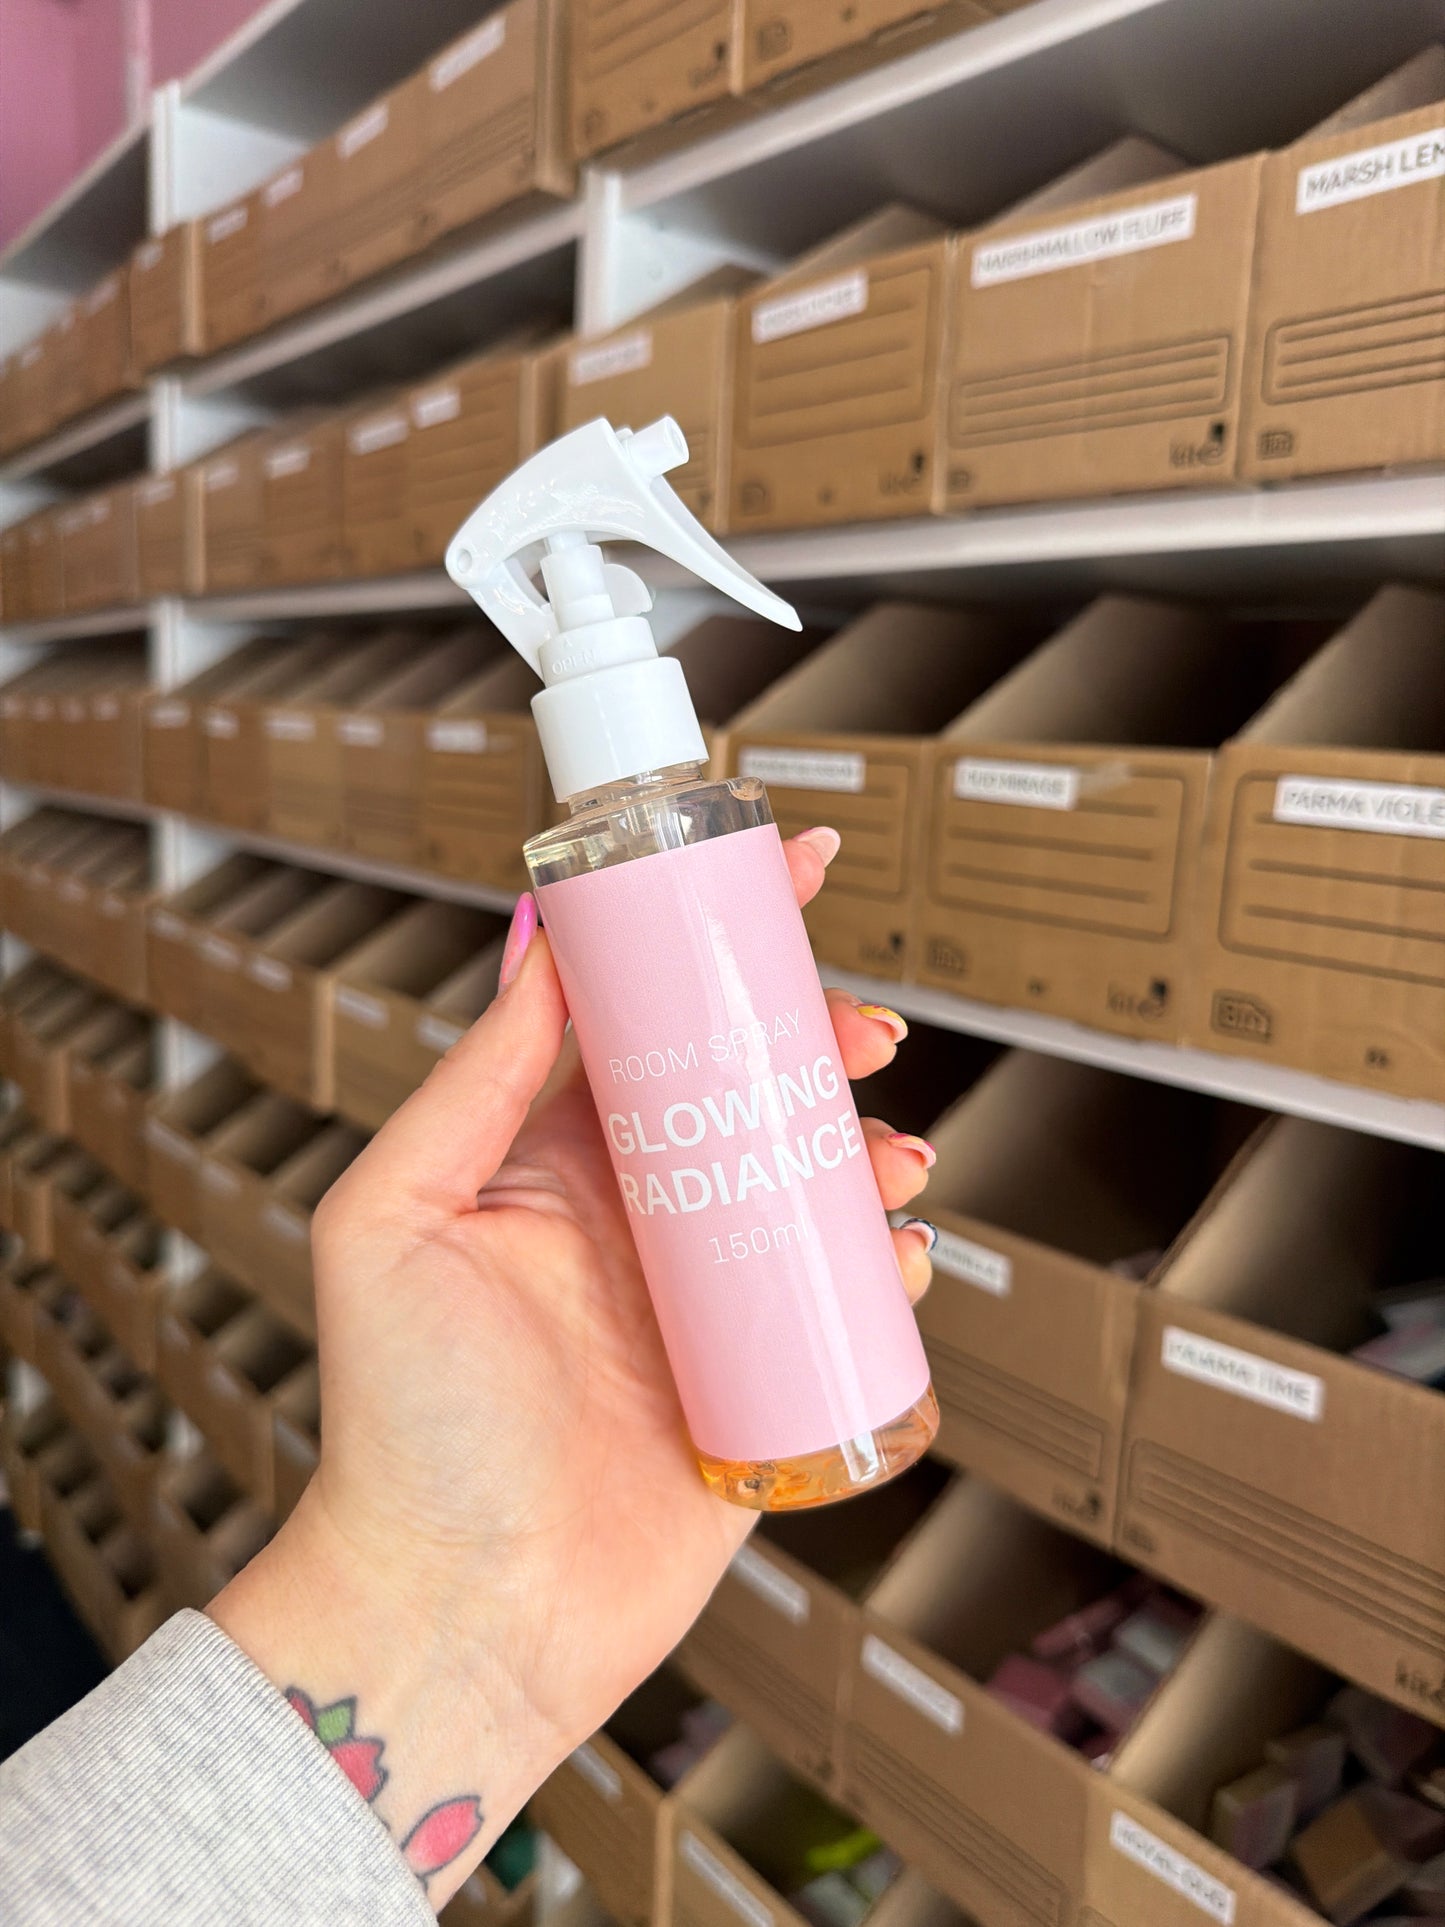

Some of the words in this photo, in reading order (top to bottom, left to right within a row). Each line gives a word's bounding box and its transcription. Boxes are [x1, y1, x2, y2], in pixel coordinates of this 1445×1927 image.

[1305, 153, 1395, 198] MARSH
[979, 225, 1119, 272] MARSHMALLOW
[1122, 206, 1187, 241] FLUFF
[1284, 786, 1363, 815] PARMA
[609, 1043, 699, 1084] ROOM
[708, 1008, 801, 1062] SPRAY
[608, 1055, 840, 1155] GLOWING
[619, 1110, 862, 1216] RADIANCE
[709, 1217, 809, 1264] 150ml
